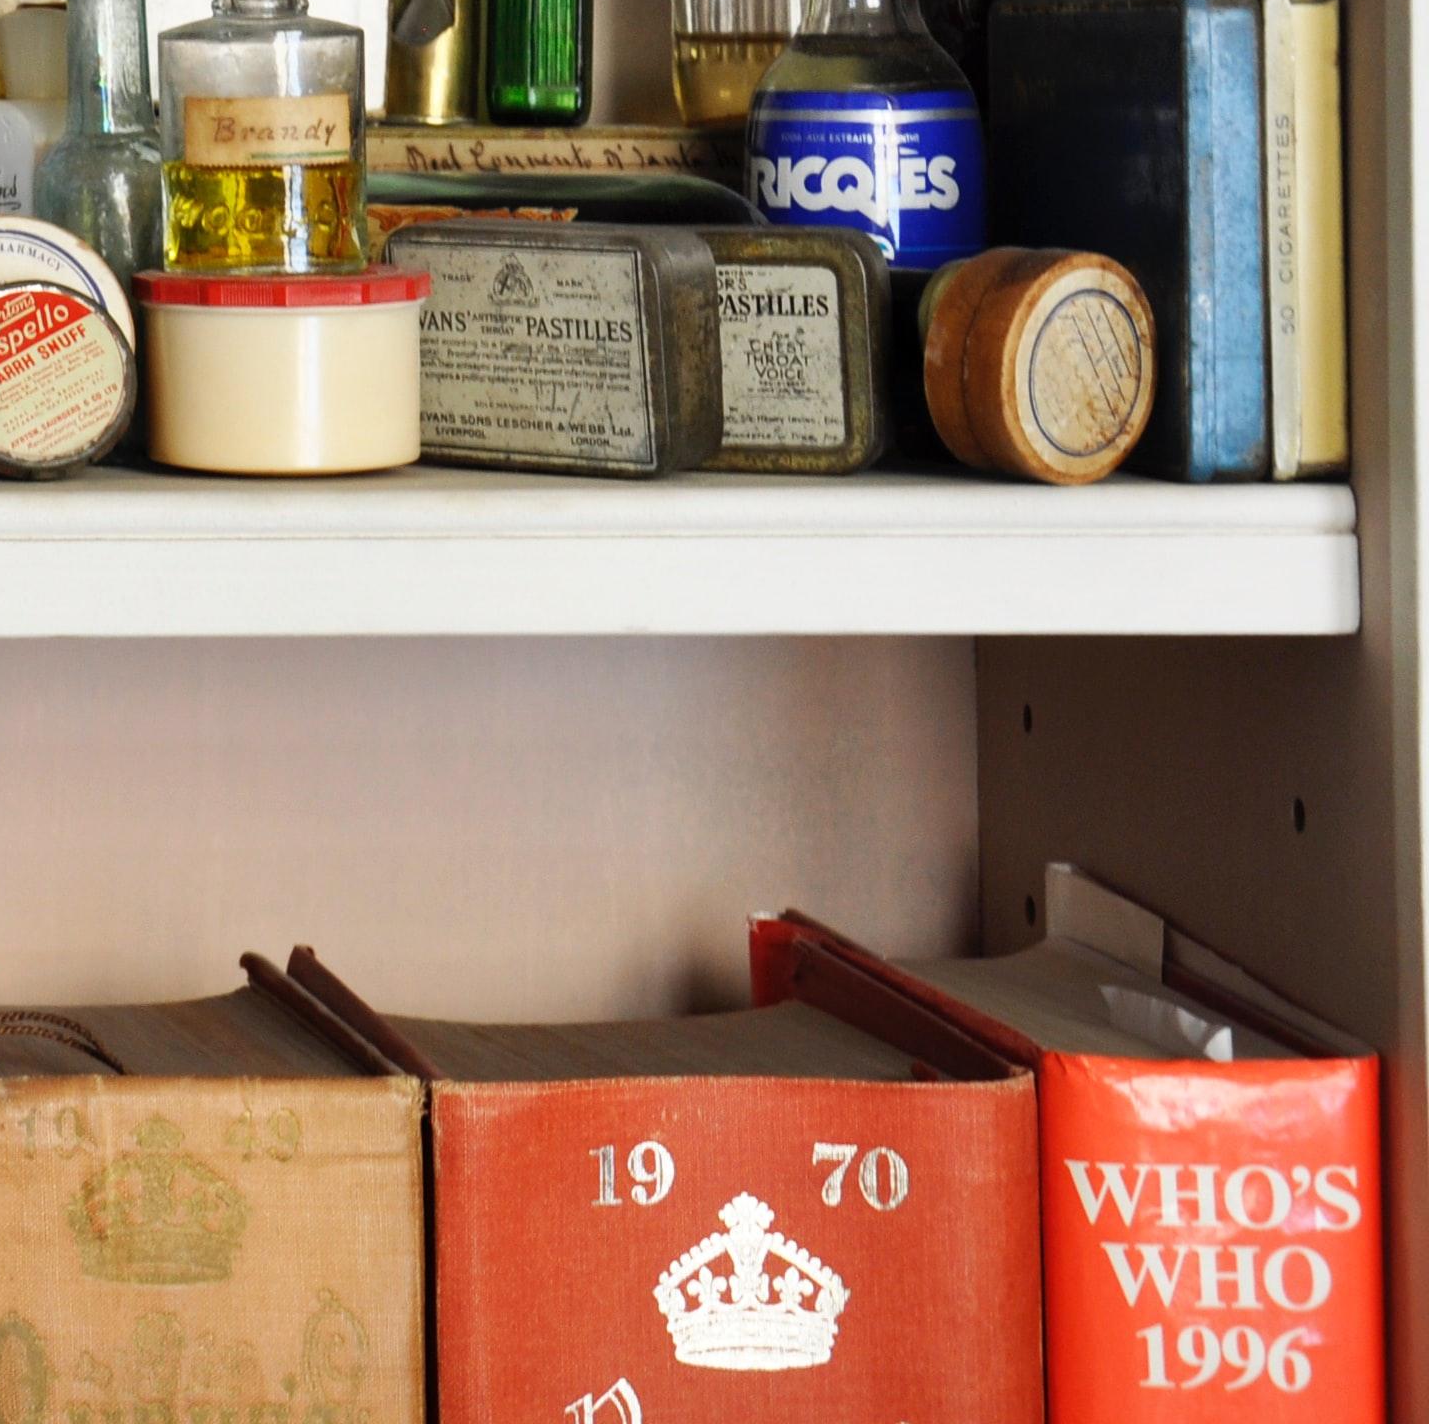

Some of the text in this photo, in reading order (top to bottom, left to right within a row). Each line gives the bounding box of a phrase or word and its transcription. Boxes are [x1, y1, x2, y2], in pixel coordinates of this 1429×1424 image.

[212, 114, 338, 150] Brandy
[749, 146, 960, 228] RICQÈS
[1275, 113, 1293, 285] CIGARETTES
[36, 322, 88, 361] SNUFF
[525, 315, 634, 344] PASTILLES
[743, 351, 811, 367] THROAT
[588, 1139, 910, 1211] 19 70
[1063, 1158, 1363, 1232] WHO'S
[1100, 1241, 1333, 1313] WHO
[1134, 1322, 1314, 1392] 1996
